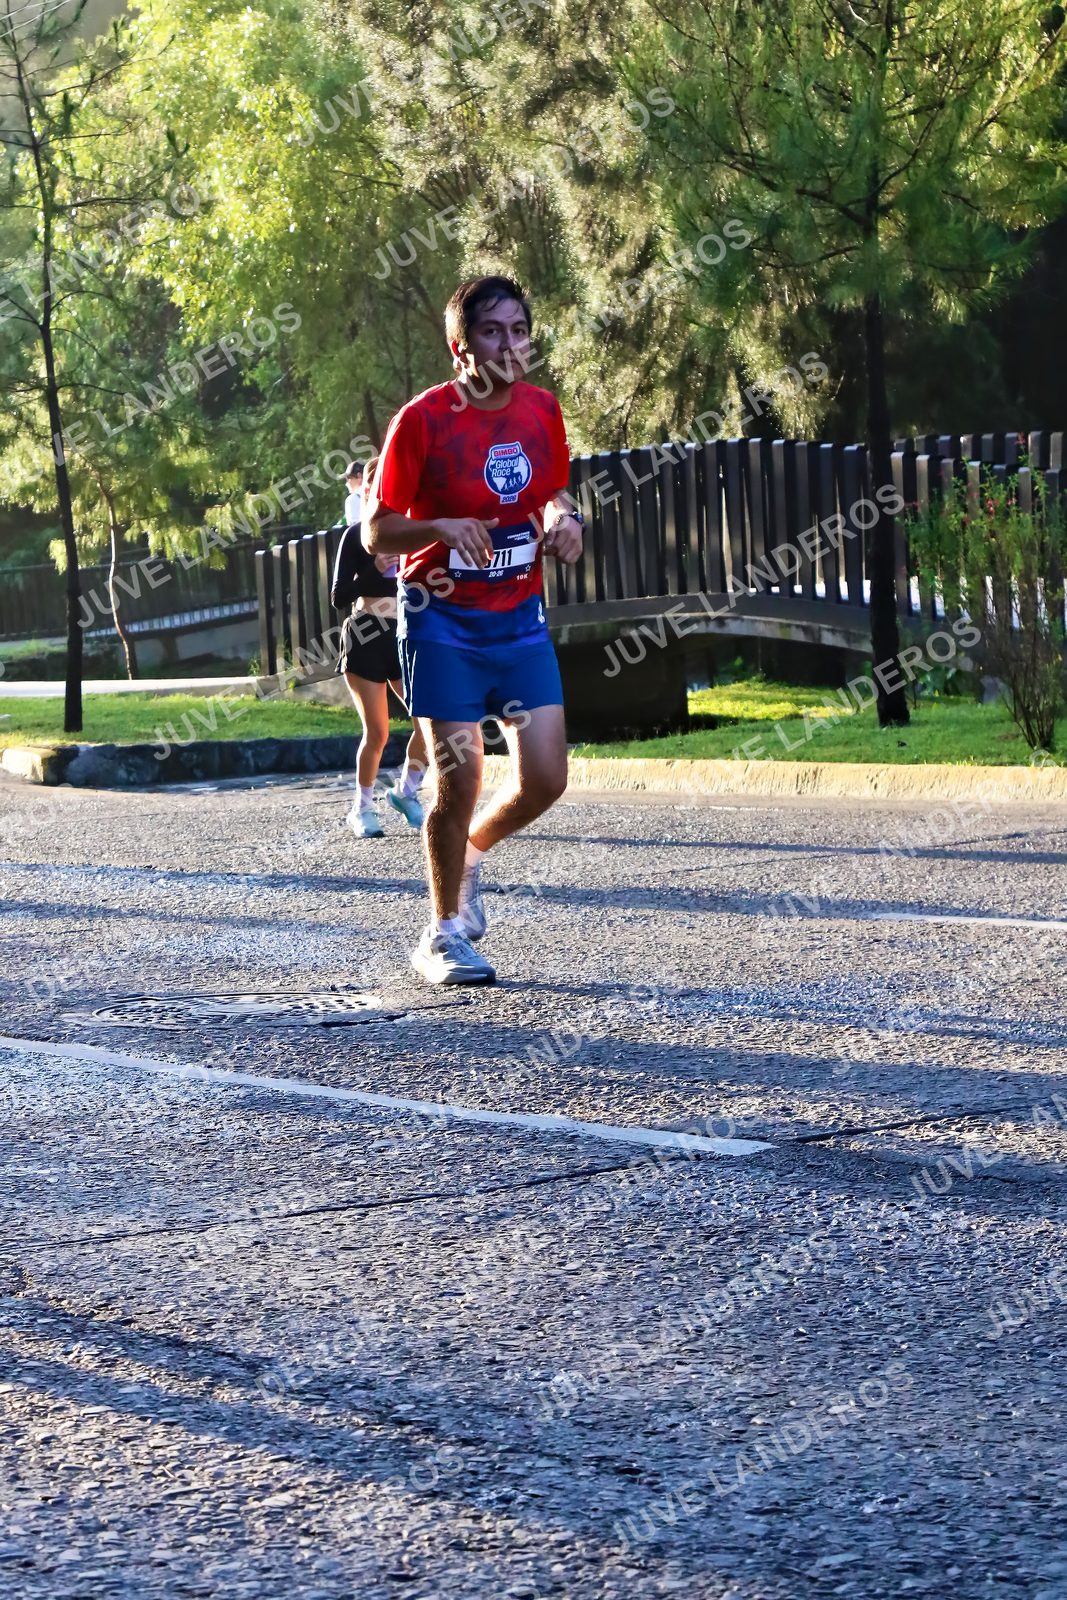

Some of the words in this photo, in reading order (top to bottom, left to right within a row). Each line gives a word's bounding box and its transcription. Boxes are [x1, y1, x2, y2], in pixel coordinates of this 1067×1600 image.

[494, 447, 518, 457] BIMBO
[496, 457, 519, 469] Global
[491, 468, 511, 478] Race
